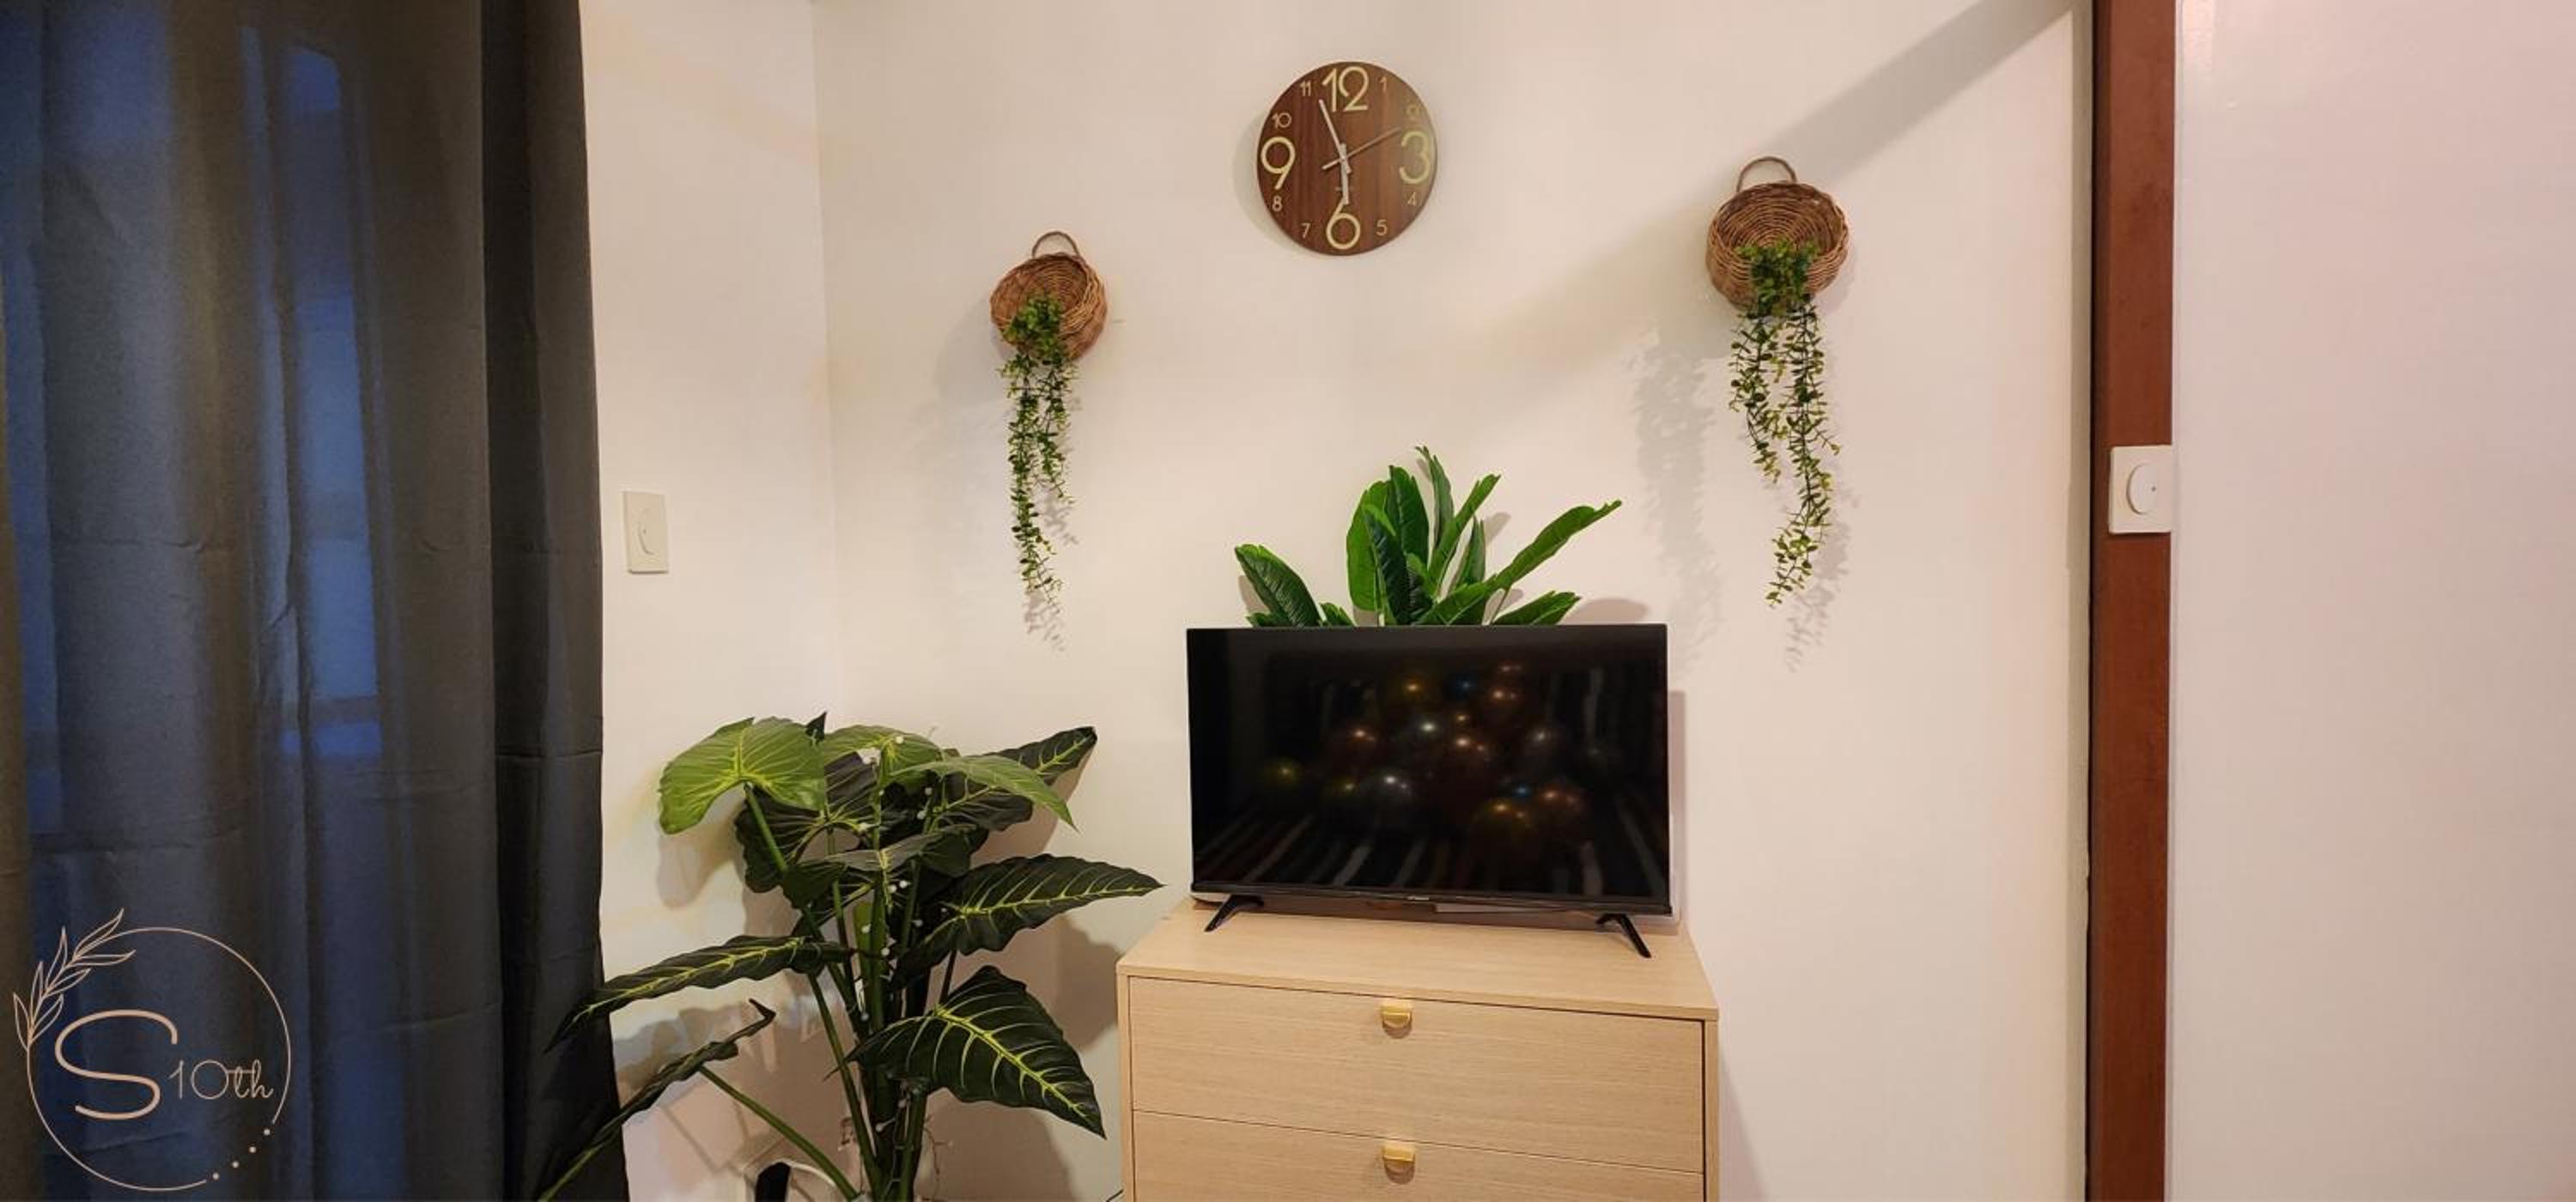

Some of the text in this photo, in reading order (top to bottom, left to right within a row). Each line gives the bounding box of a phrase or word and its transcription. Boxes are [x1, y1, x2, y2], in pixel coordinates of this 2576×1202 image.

[1300, 81, 1311, 96] 11
[1321, 66, 1369, 112] 12
[1380, 76, 1388, 93] 1
[1272, 112, 1291, 128] 10
[1261, 137, 1296, 190] 9
[1399, 131, 1430, 184] 3
[1272, 196, 1283, 211] 8
[1407, 191, 1417, 206] 4
[1301, 222, 1311, 238] 7
[1326, 197, 1361, 250] 6
[1376, 219, 1388, 236] 5
